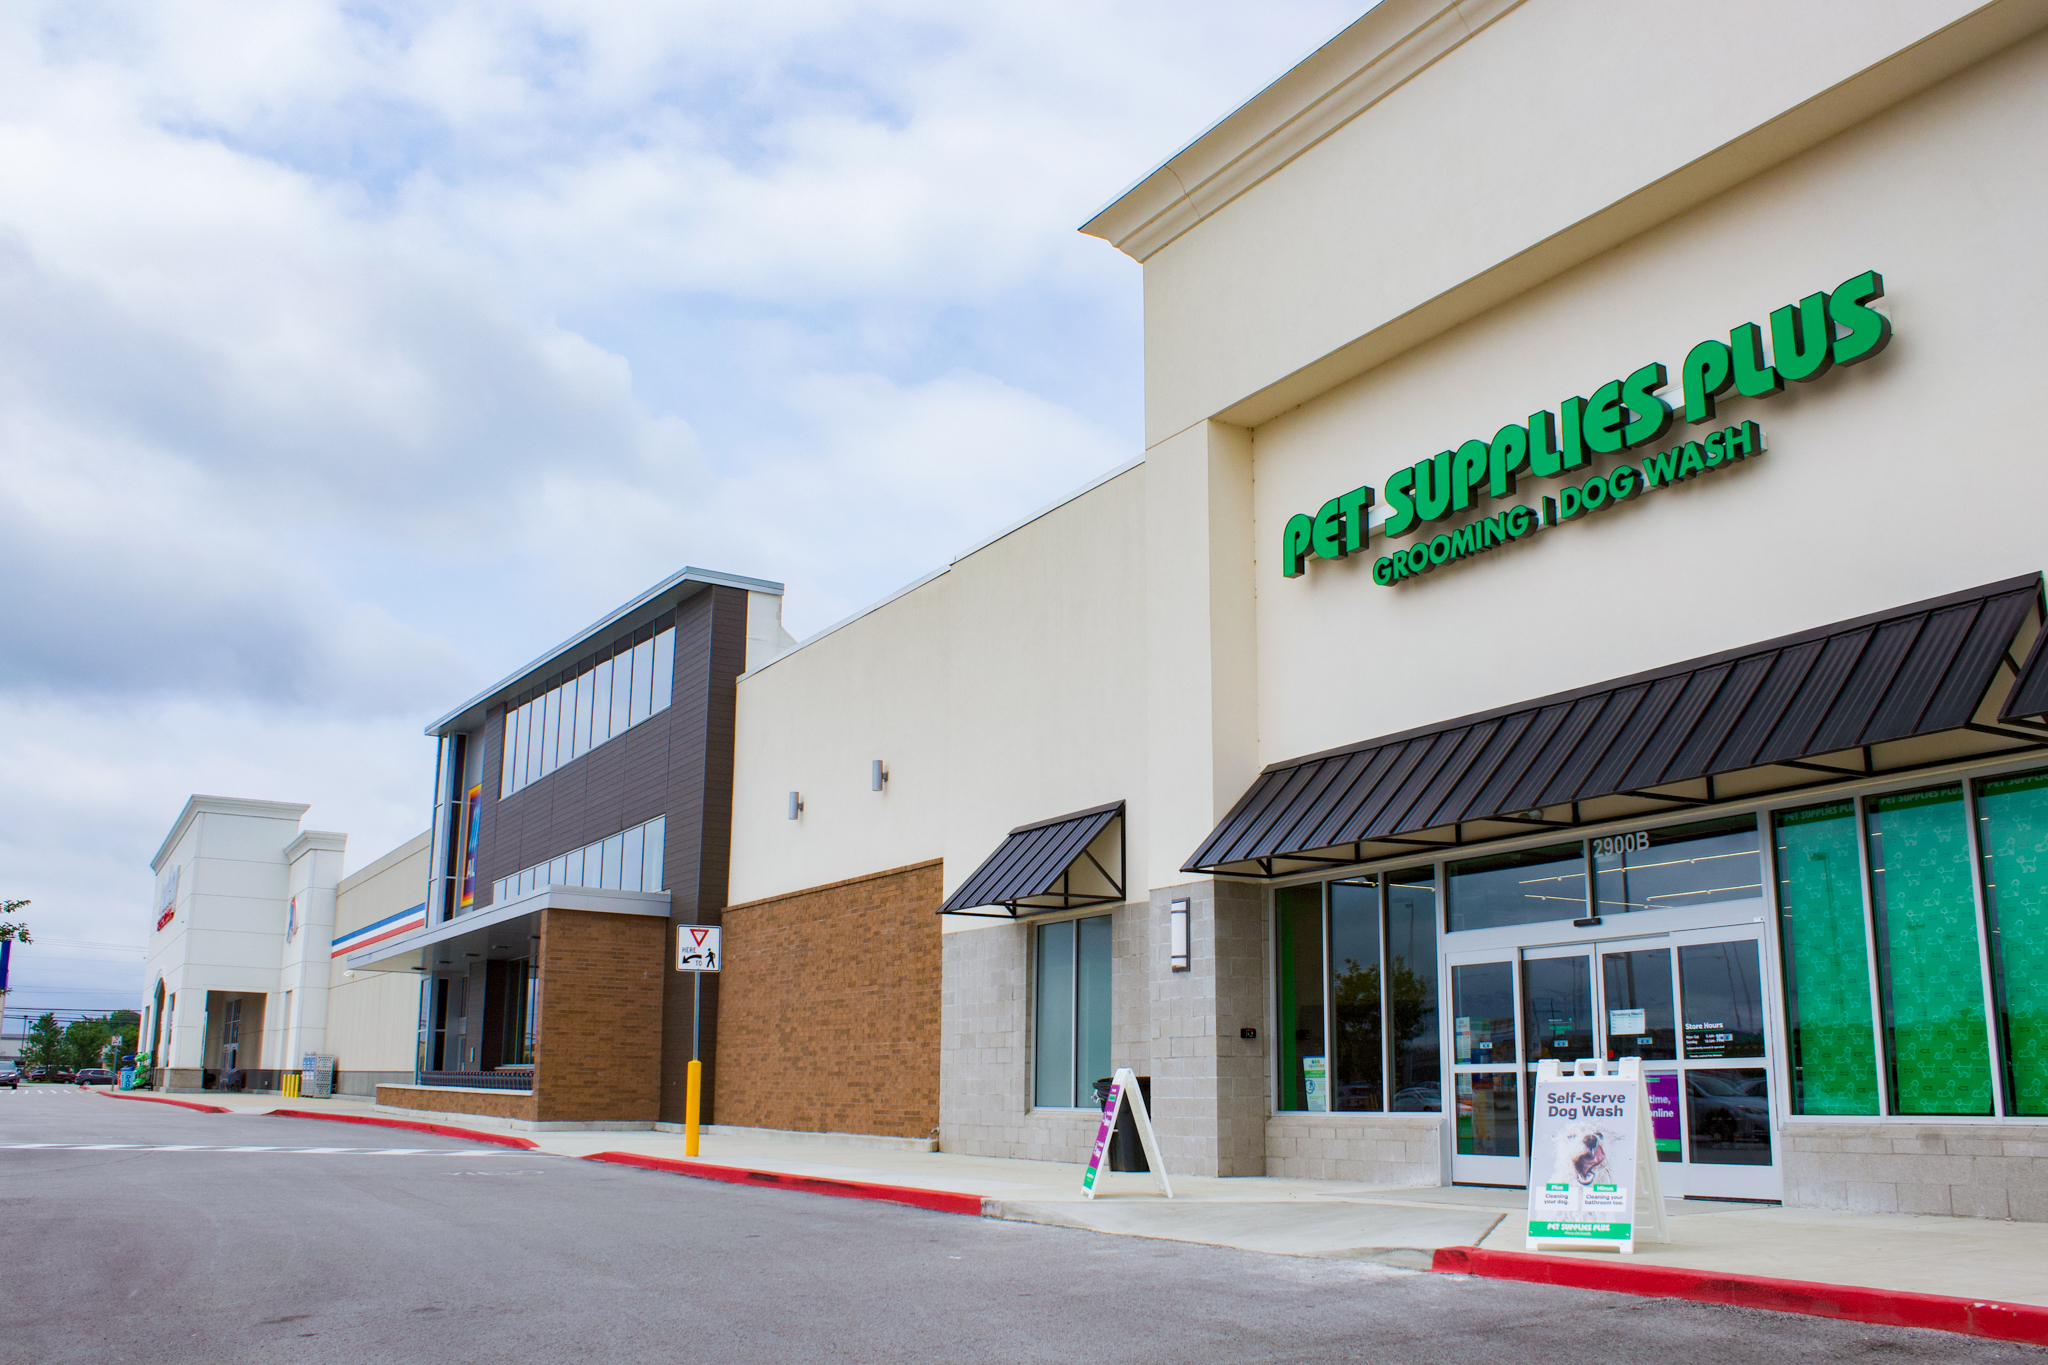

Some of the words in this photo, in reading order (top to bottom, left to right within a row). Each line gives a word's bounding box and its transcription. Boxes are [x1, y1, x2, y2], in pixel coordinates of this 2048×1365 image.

[1284, 486, 1373, 578] PET
[1385, 362, 1672, 538] SUPPLIES
[1683, 270, 1891, 424] PLUS
[1373, 504, 1537, 587] GROOMING
[1560, 465, 1643, 521] DOG
[1643, 420, 1761, 489] WASH
[1784, 812, 1799, 821] PET
[1801, 805, 1838, 819] SUPPLIES
[1840, 803, 1855, 813] PLU
[1593, 831, 1650, 858] 2900B
[1547, 1092, 1626, 1104] Self-Serve
[1649, 1095, 1671, 1105] time,
[1548, 1105, 1577, 1120] Dog
[1581, 1105, 1623, 1117] Wash
[1561, 1223, 1592, 1231] SUPPLIES
